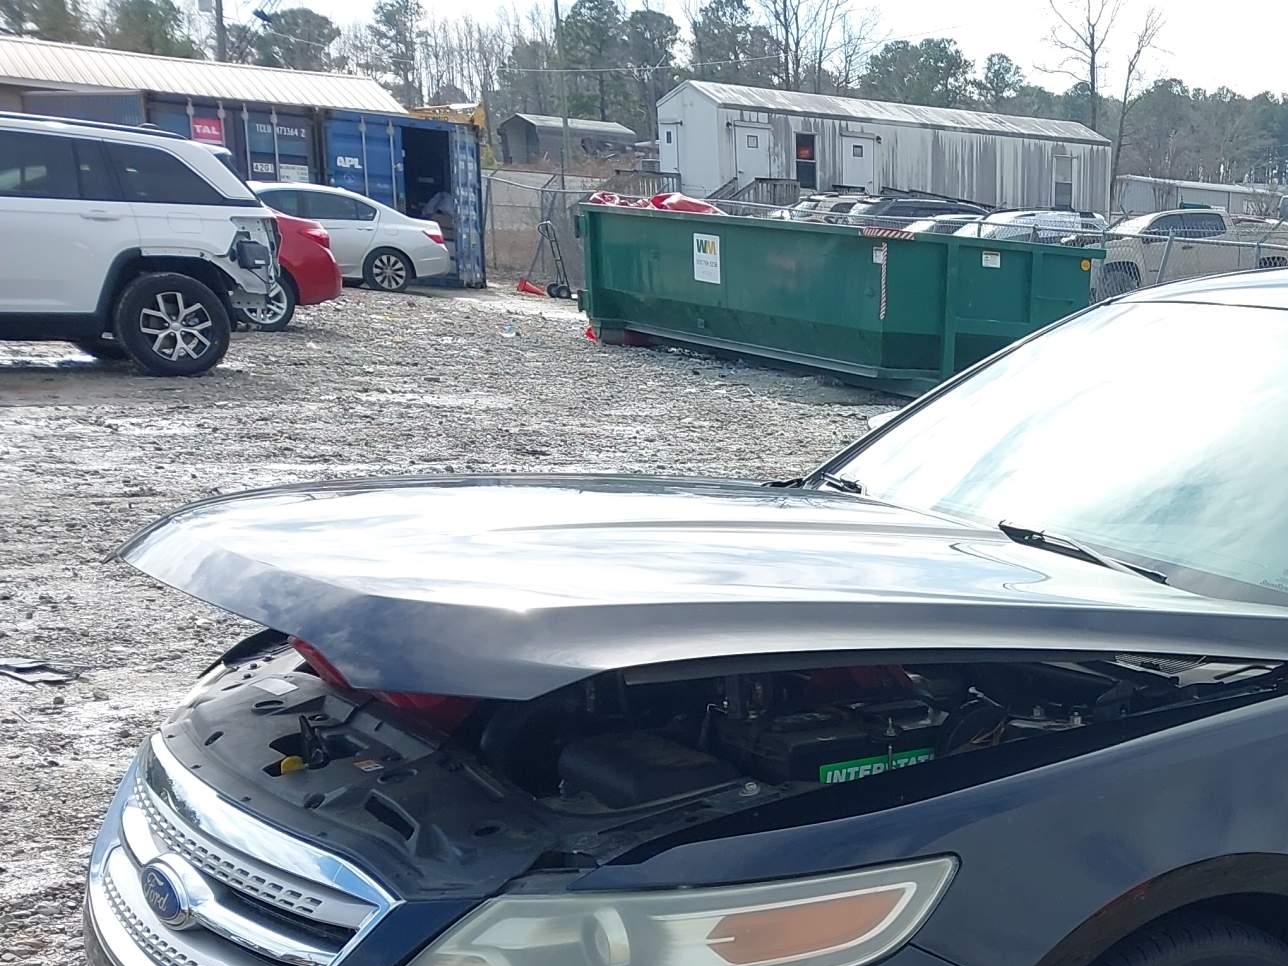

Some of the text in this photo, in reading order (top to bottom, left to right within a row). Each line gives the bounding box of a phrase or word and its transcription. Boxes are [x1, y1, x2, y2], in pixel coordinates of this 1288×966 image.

[192, 124, 220, 135] TAL
[336, 156, 363, 168] APL
[696, 239, 717, 255] WM
[144, 871, 169, 912] Ford
